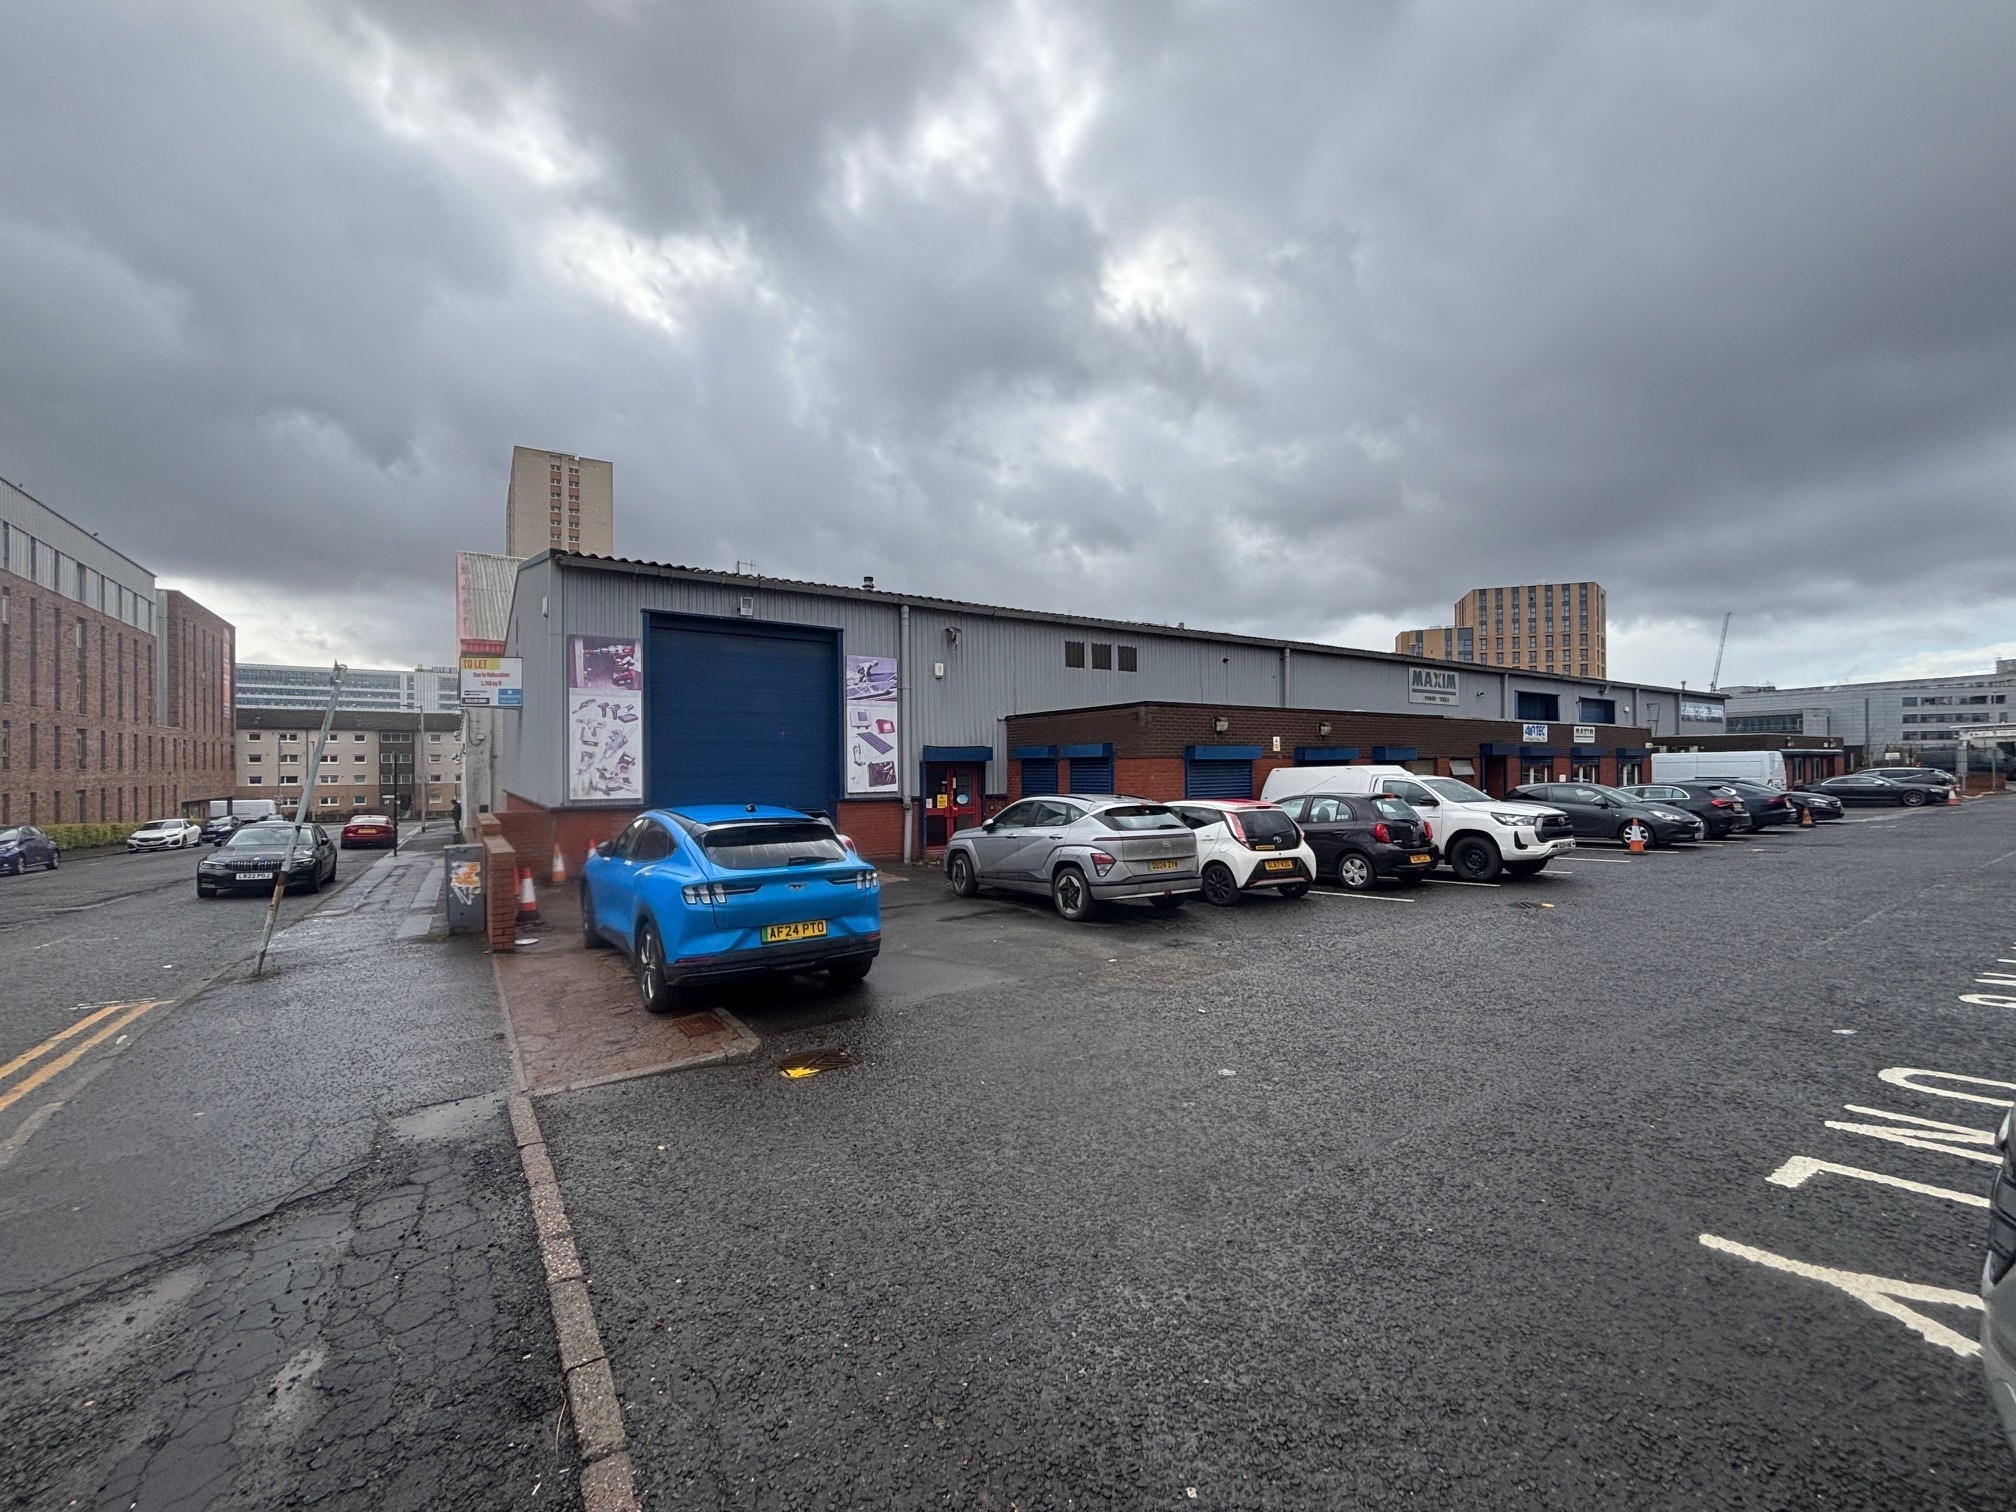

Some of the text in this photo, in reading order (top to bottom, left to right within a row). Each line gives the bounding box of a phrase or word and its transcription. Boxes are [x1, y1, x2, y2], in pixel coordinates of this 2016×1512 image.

[463, 659, 487, 669] TO LET
[1411, 669, 1456, 690] MAXIM
[769, 922, 824, 939] AF24 PTO
